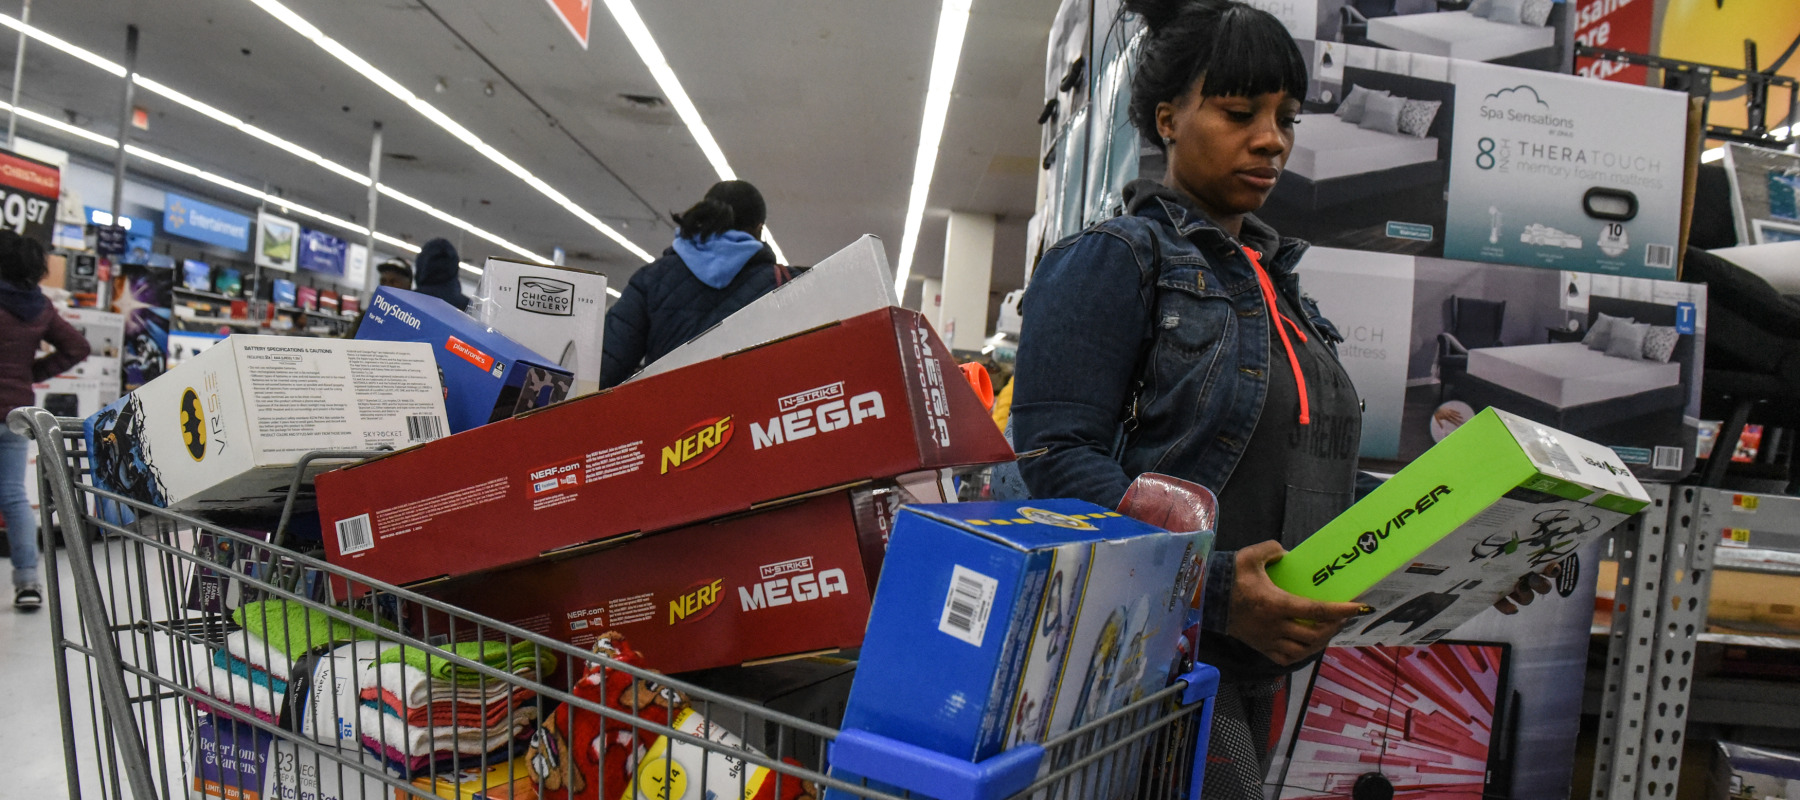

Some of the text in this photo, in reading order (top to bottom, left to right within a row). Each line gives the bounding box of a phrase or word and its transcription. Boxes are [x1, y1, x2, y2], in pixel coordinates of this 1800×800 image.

[1480, 105, 1574, 129] Spa Sensations
[1475, 136, 1496, 170] 8
[1499, 138, 1511, 174] INCH
[1516, 160, 1663, 190] memory foam mattress
[1607, 223, 1623, 237] 10
[521, 291, 569, 305] CHICAGO
[521, 299, 568, 312] CUTLERY
[374, 294, 421, 330] PlayStation
[1680, 305, 1692, 323] T
[267, 346, 305, 354] SPECIFICATIONS
[453, 341, 486, 364] plantronics
[783, 385, 839, 407] N-STRIKE
[918, 327, 951, 448] MEGA
[749, 390, 886, 451] MEGA
[660, 415, 732, 475] NERF
[530, 462, 580, 481] NERF.com
[1312, 484, 1453, 587] SKY VIPER
[763, 558, 809, 576] N-STRIKE
[737, 567, 849, 612] MEGA
[566, 607, 605, 620] NERF.com
[669, 578, 724, 626] NERF
[343, 722, 353, 738] 18
